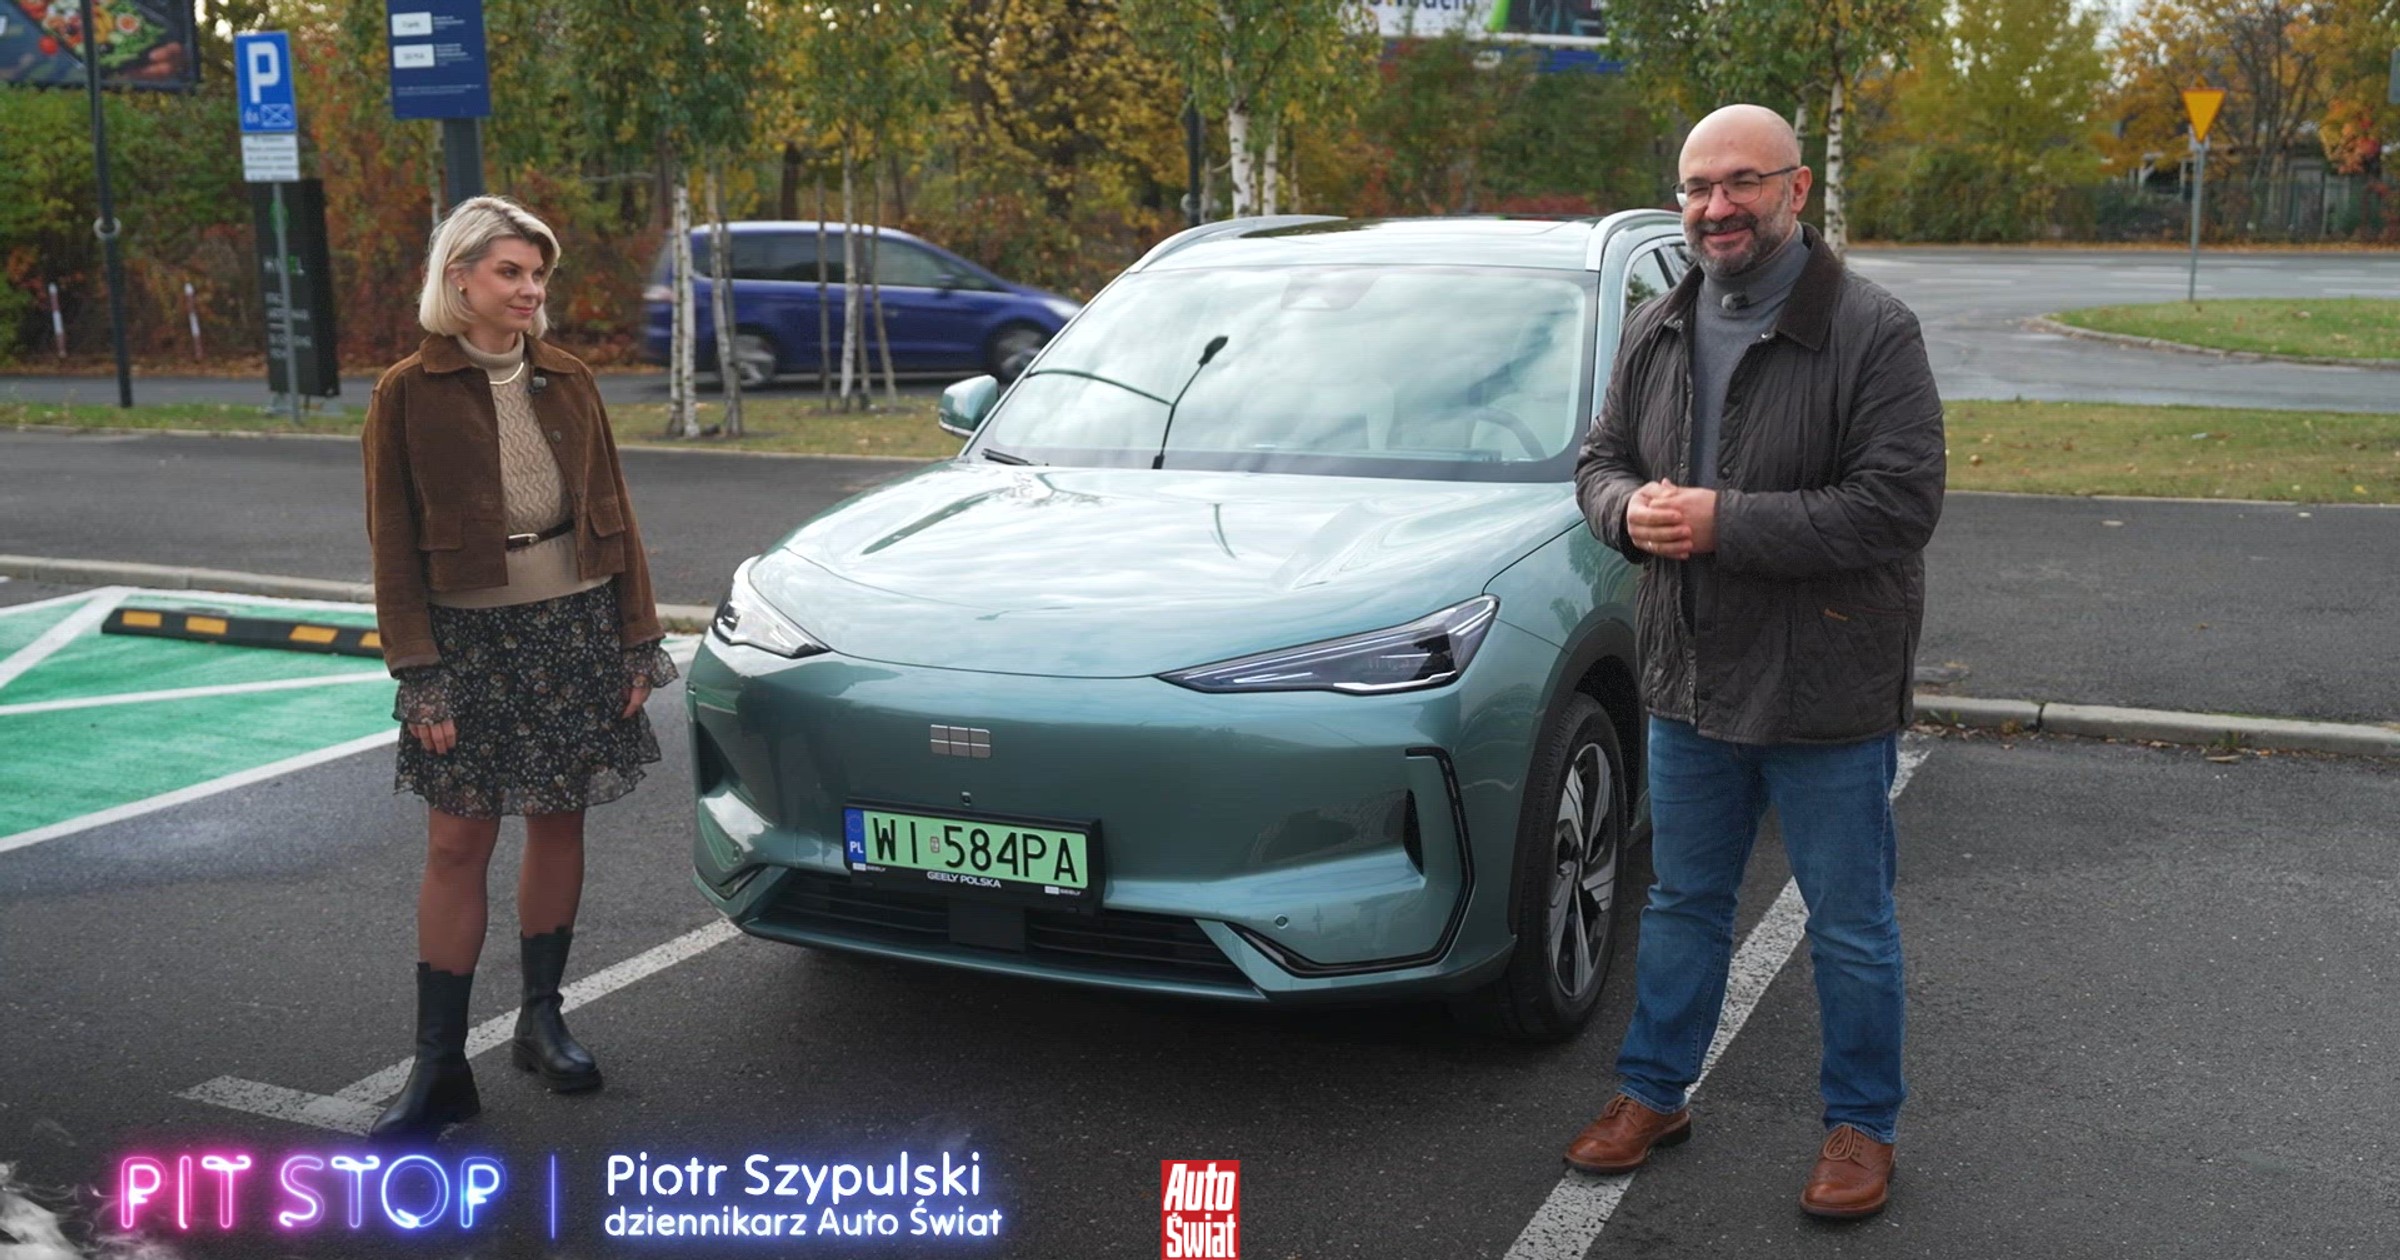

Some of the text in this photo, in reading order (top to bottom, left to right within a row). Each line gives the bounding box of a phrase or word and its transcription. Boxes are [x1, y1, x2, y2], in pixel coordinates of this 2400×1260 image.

[247, 41, 280, 104] P
[850, 841, 864, 854] PL
[873, 817, 1078, 883] WI 584PA
[927, 870, 1002, 889] GEELY POLSKA
